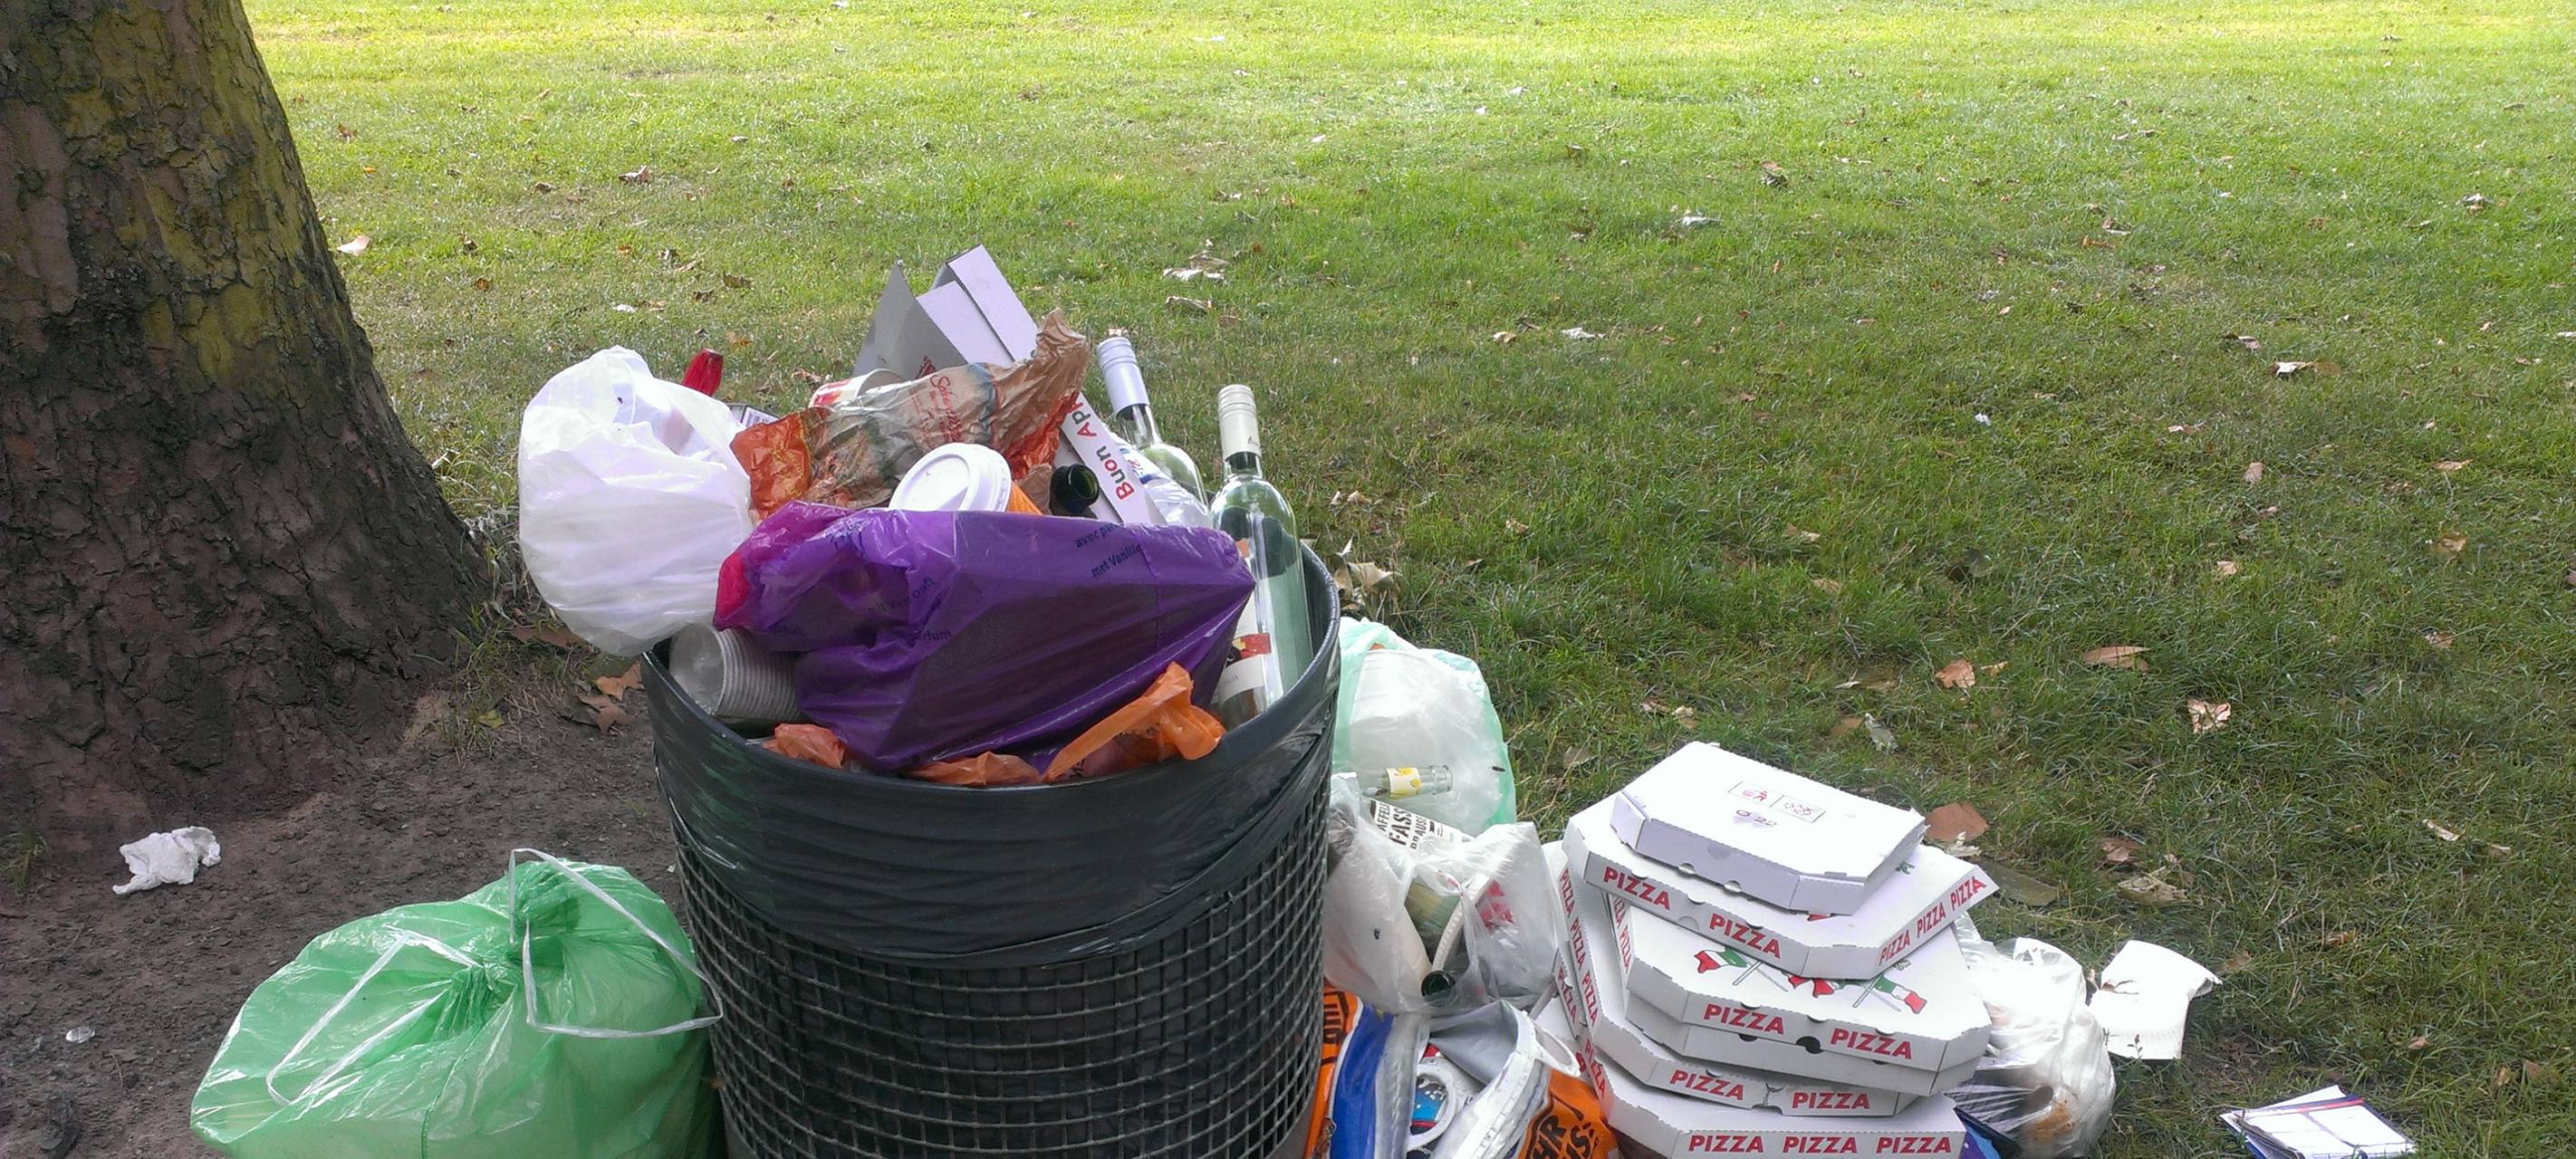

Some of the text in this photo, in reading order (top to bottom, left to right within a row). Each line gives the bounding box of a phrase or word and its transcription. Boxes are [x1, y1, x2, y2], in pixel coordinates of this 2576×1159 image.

[1096, 445, 1135, 500] Buon
[1376, 801, 1390, 832] AFFELS
[1603, 866, 1781, 959] PIZZA PIZZA
[1879, 876, 1987, 966] PIZZA PIZZA PIZZA
[1561, 867, 1599, 1027] PIZZA PIZZA PIZZA
[1620, 924, 1631, 973] PIZZA
[1558, 967, 1577, 1024] PIZZA
[1704, 1003, 1912, 1059] PIZZA PIZZA
[1585, 1039, 1606, 1099] PIZZA
[1670, 1069, 1870, 1109] PIZZA PIZZA
[1688, 1135, 1952, 1154] PIZZA PIZZA PIZZA
